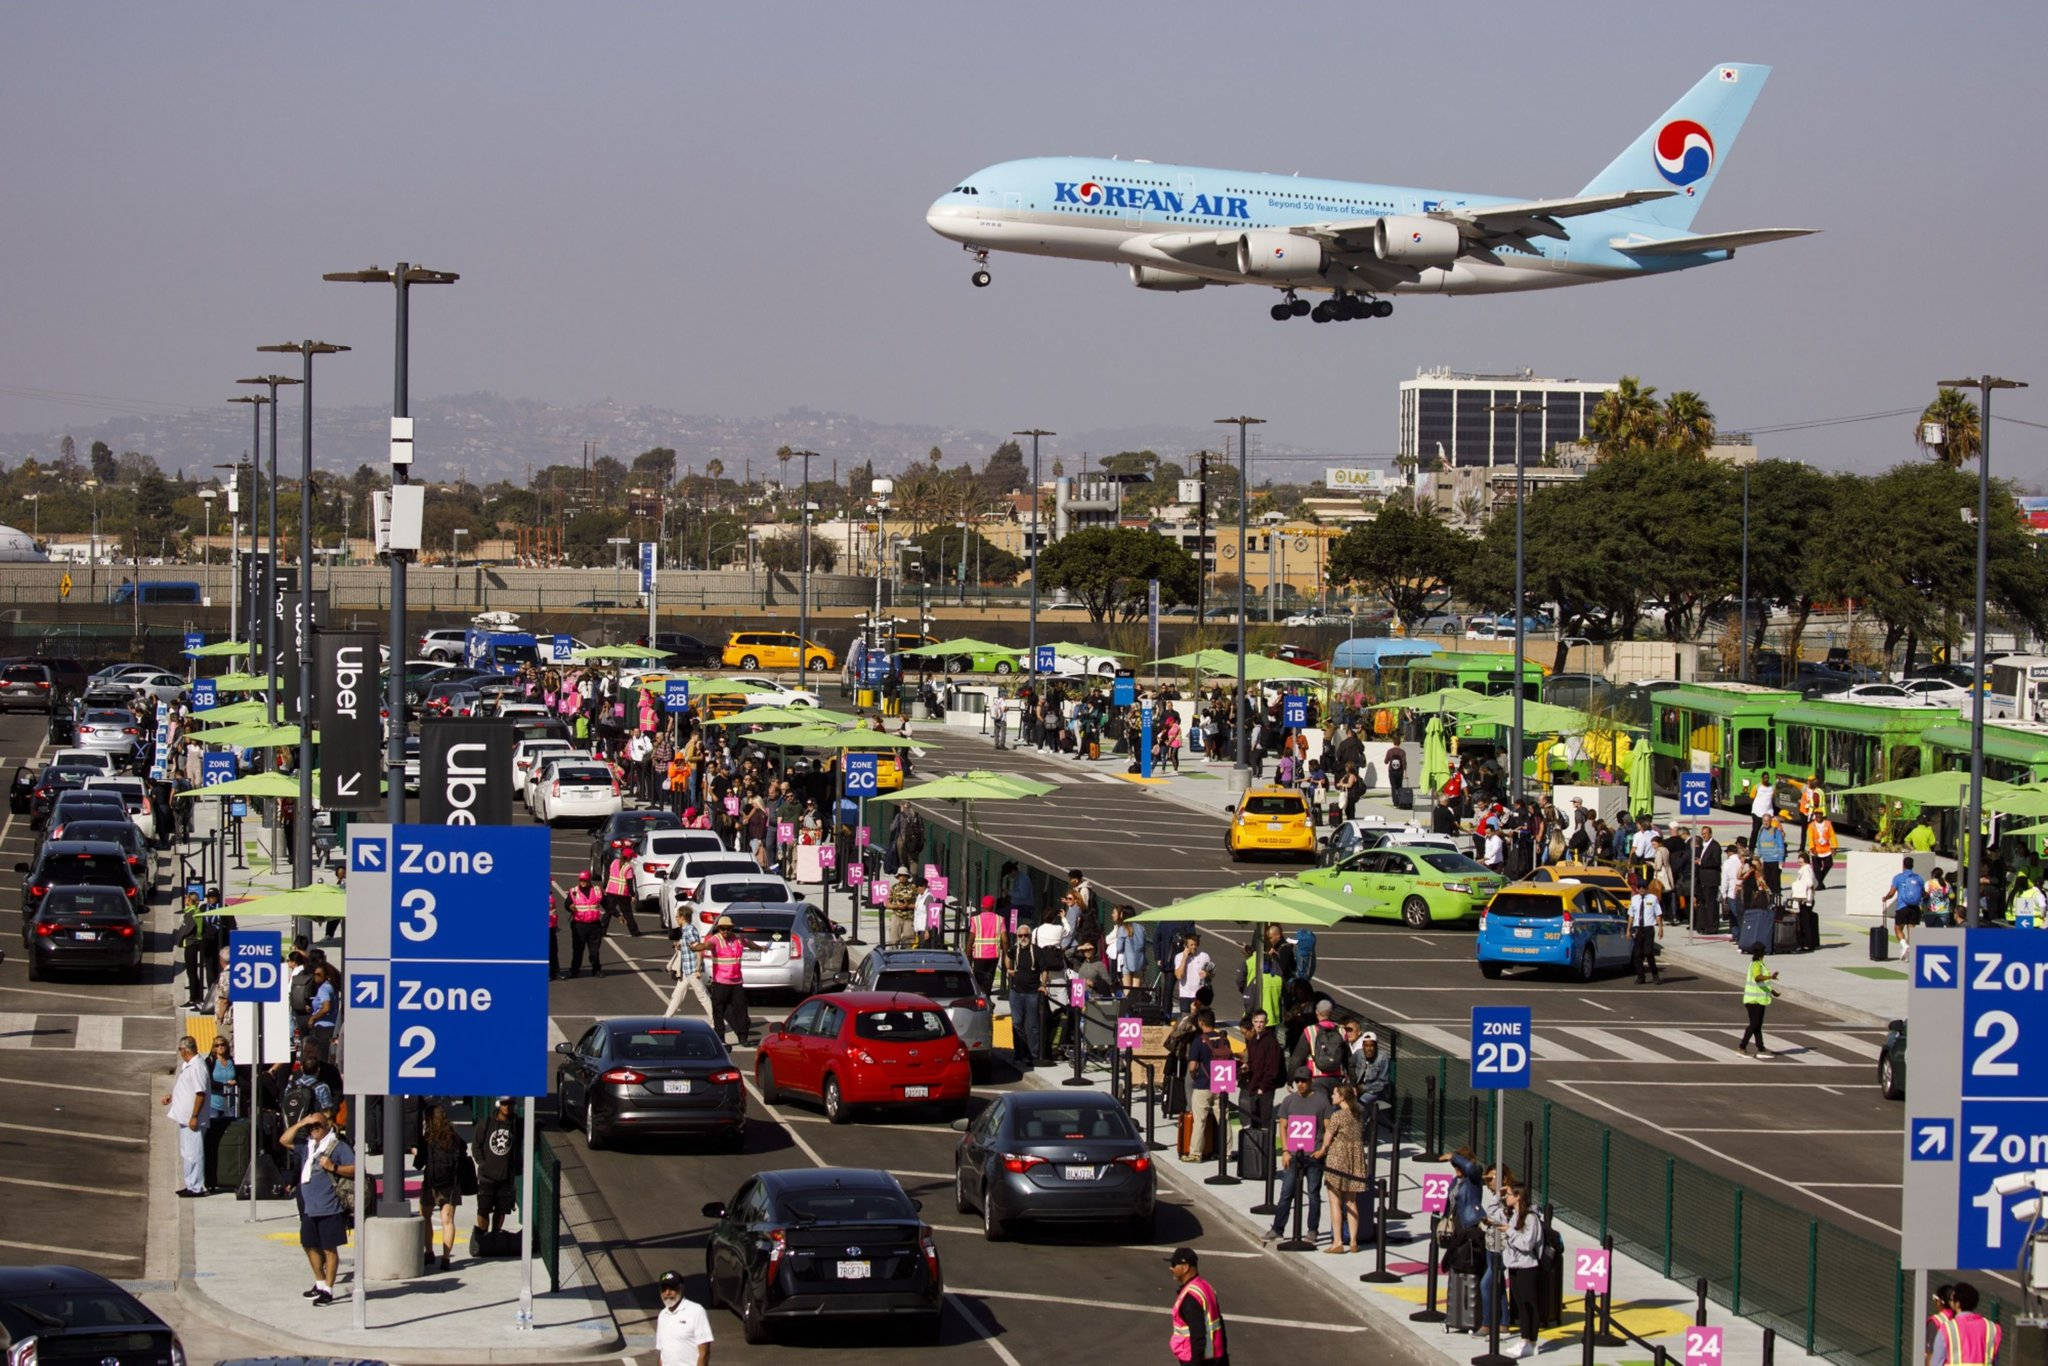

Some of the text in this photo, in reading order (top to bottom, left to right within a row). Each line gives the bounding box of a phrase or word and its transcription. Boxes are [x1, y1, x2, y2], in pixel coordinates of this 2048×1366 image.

[1054, 182, 1250, 220] KOREAN AIR
[1268, 199, 1301, 209] Beyond
[1303, 202, 1314, 210] 50
[1316, 202, 1338, 213] Years
[1339, 205, 1349, 213] of
[555, 645, 571, 656] 2A
[1039, 657, 1054, 667] 1A
[336, 646, 363, 720] Uber
[194, 693, 215, 706] 3B
[667, 694, 687, 706] 2B
[1286, 709, 1305, 722] 1B
[208, 760, 230, 768] ZONE
[851, 761, 873, 769] ZONE
[206, 771, 233, 787] 3C
[446, 743, 487, 826] Ube
[848, 771, 875, 789] 2C
[1686, 780, 1707, 788] ZONE
[1683, 790, 1709, 808] 1C
[779, 827, 791, 837] 13
[399, 843, 494, 874] Zone
[820, 849, 833, 861] 14
[849, 867, 862, 878] 15
[873, 884, 888, 896] 16
[399, 888, 438, 942] 3
[929, 907, 940, 919] 17
[238, 944, 273, 957] ZONE
[233, 962, 278, 989] 3D
[1972, 952, 2048, 992] Zon
[397, 980, 493, 1011] Zone
[1072, 983, 1083, 998] 19
[1119, 1022, 1141, 1038] 20
[1482, 1022, 1522, 1036] ZONE
[1971, 1009, 2019, 1076] 2
[397, 1025, 437, 1078] 2
[1476, 1042, 1527, 1073] 2D
[1214, 1065, 1233, 1082] 21
[1289, 1120, 1313, 1139] 22
[1968, 1125, 2048, 1164] Zon
[1425, 1179, 1450, 1200] 23
[1972, 1180, 2002, 1248] 1
[1576, 1254, 1608, 1278] 24
[1687, 1332, 1721, 1358] 24
